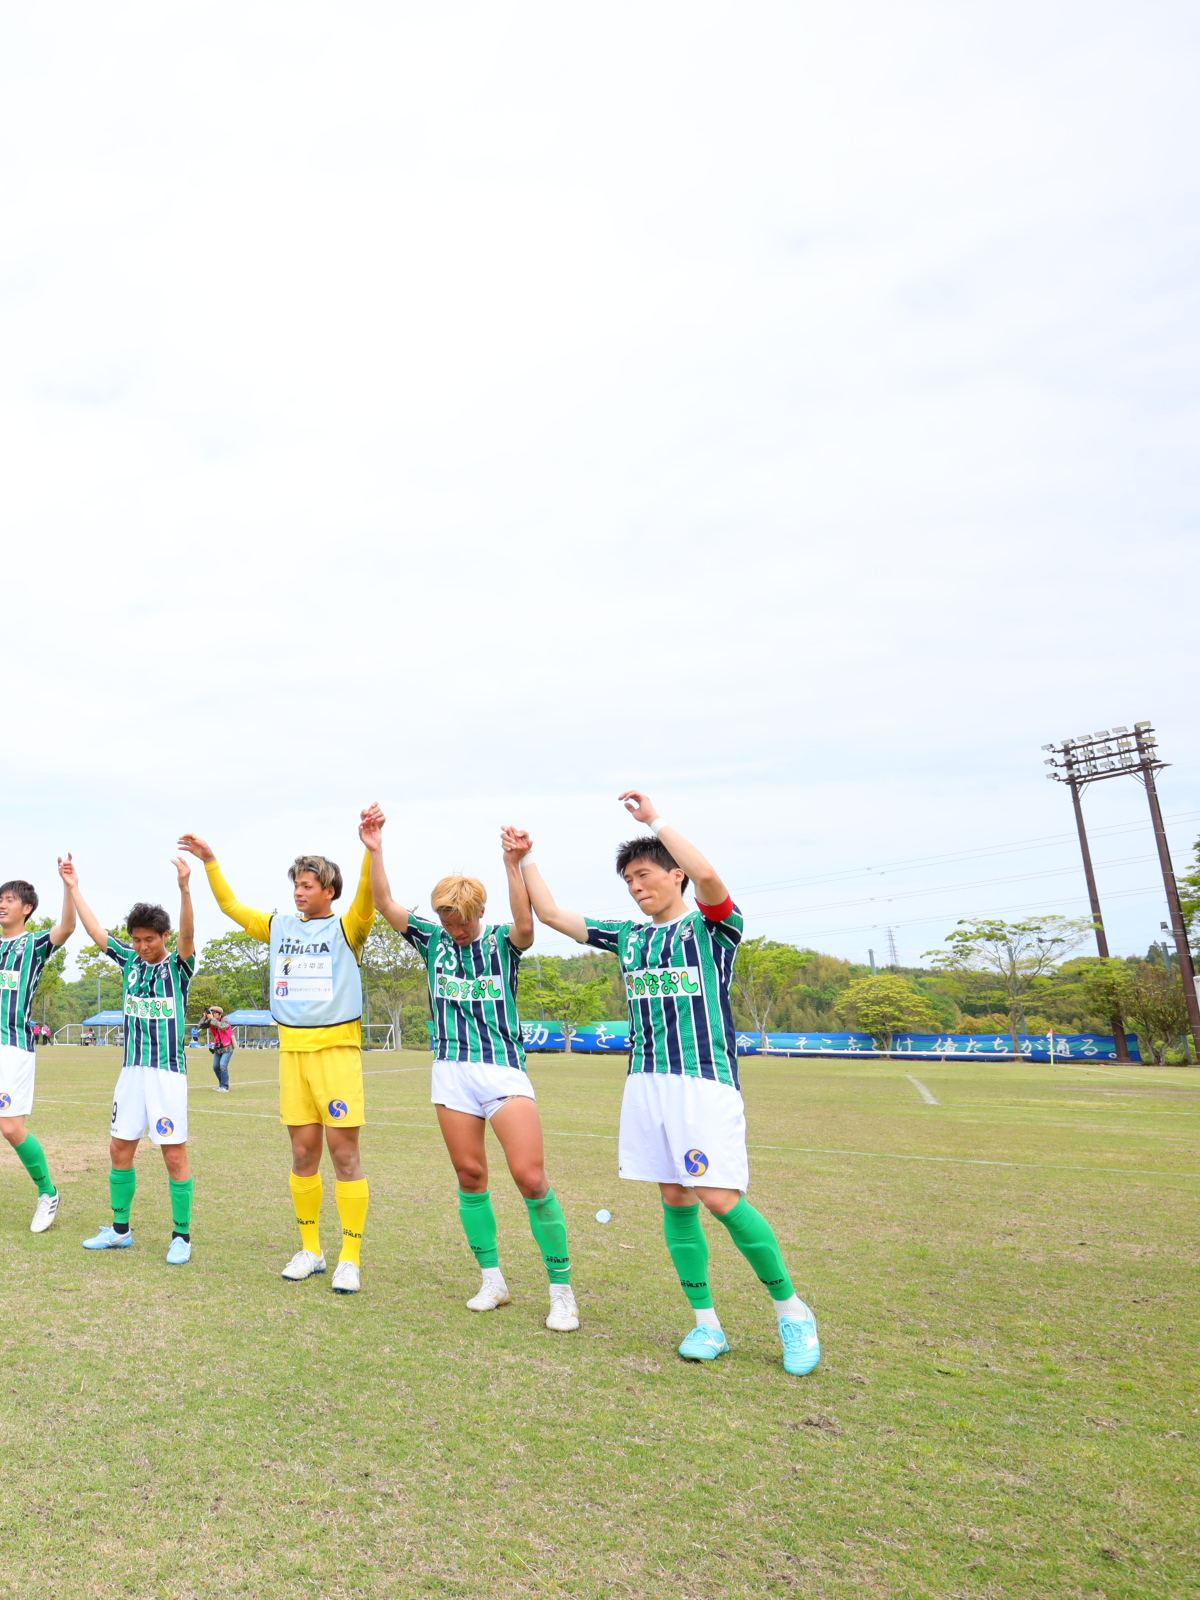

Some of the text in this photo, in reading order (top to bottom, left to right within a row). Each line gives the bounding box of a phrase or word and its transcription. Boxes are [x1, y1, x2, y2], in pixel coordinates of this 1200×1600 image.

[434, 942, 457, 970] 23
[623, 936, 639, 965] 5
[128, 969, 138, 989] 9
